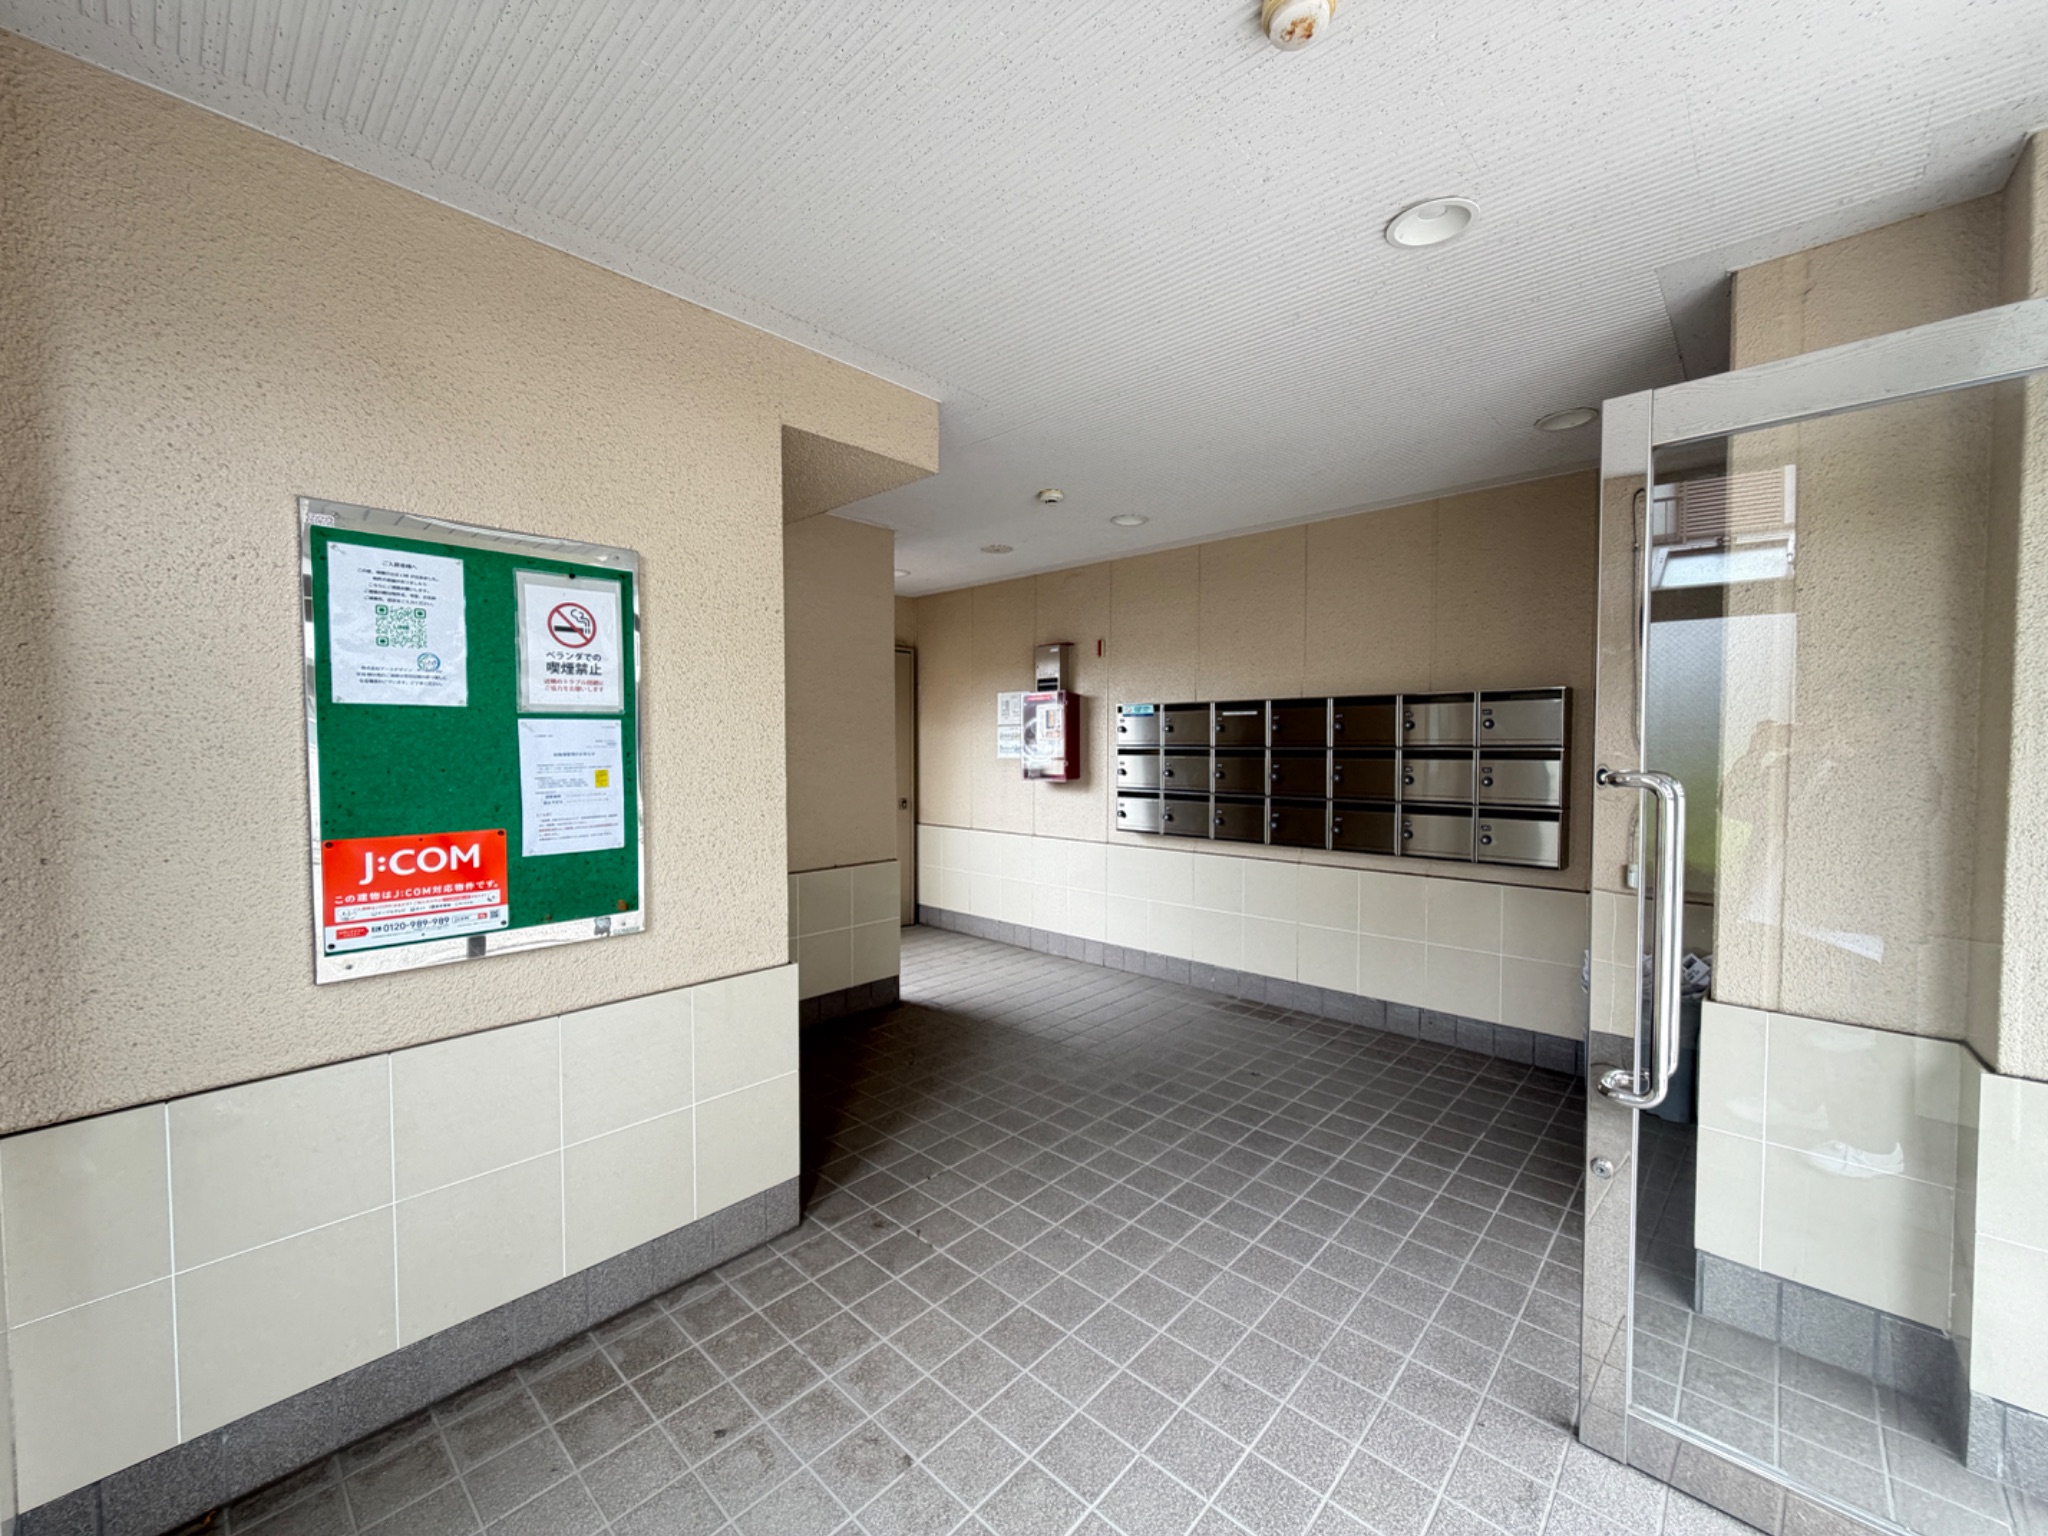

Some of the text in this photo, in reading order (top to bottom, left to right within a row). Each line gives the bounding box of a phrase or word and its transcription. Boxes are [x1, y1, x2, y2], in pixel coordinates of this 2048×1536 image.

[545, 651, 602, 662] ベランダでの
[545, 661, 603, 676] 喫煙禁止
[358, 843, 480, 886] J:COM
[334, 879, 499, 905] この建物はJ:COM対応物件です。
[382, 916, 451, 934] 0120-989-989
